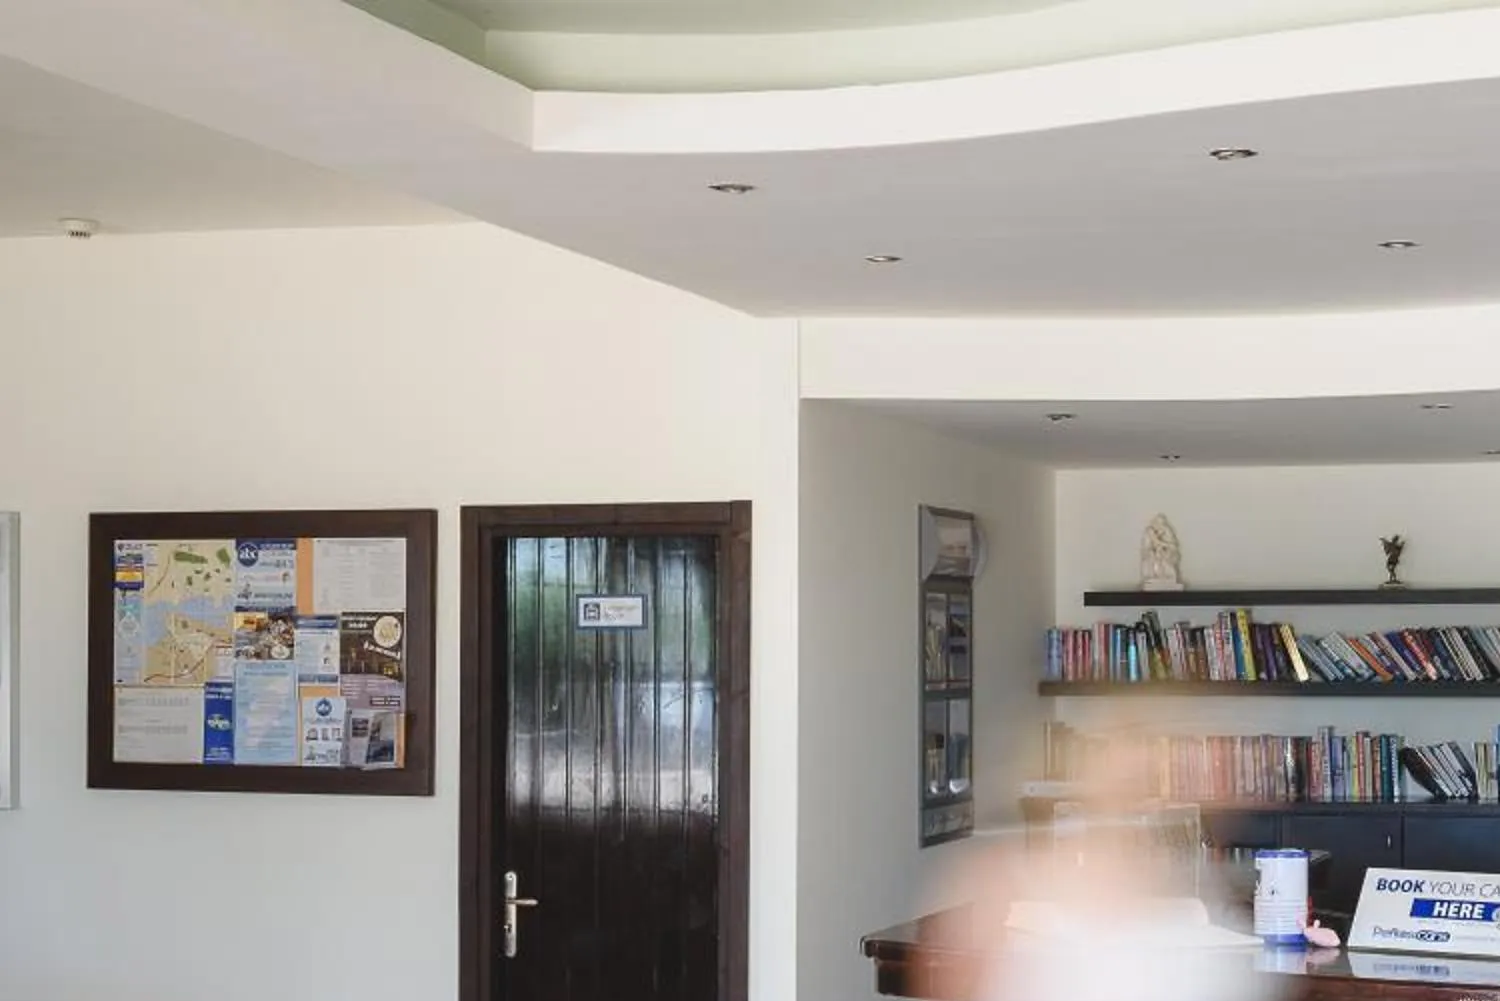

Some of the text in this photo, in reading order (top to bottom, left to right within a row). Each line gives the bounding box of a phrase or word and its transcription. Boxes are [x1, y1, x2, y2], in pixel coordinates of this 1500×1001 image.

[1376, 878, 1424, 893] BOOK
[1429, 880, 1476, 896] YOUR
[1431, 900, 1485, 919] HERE
